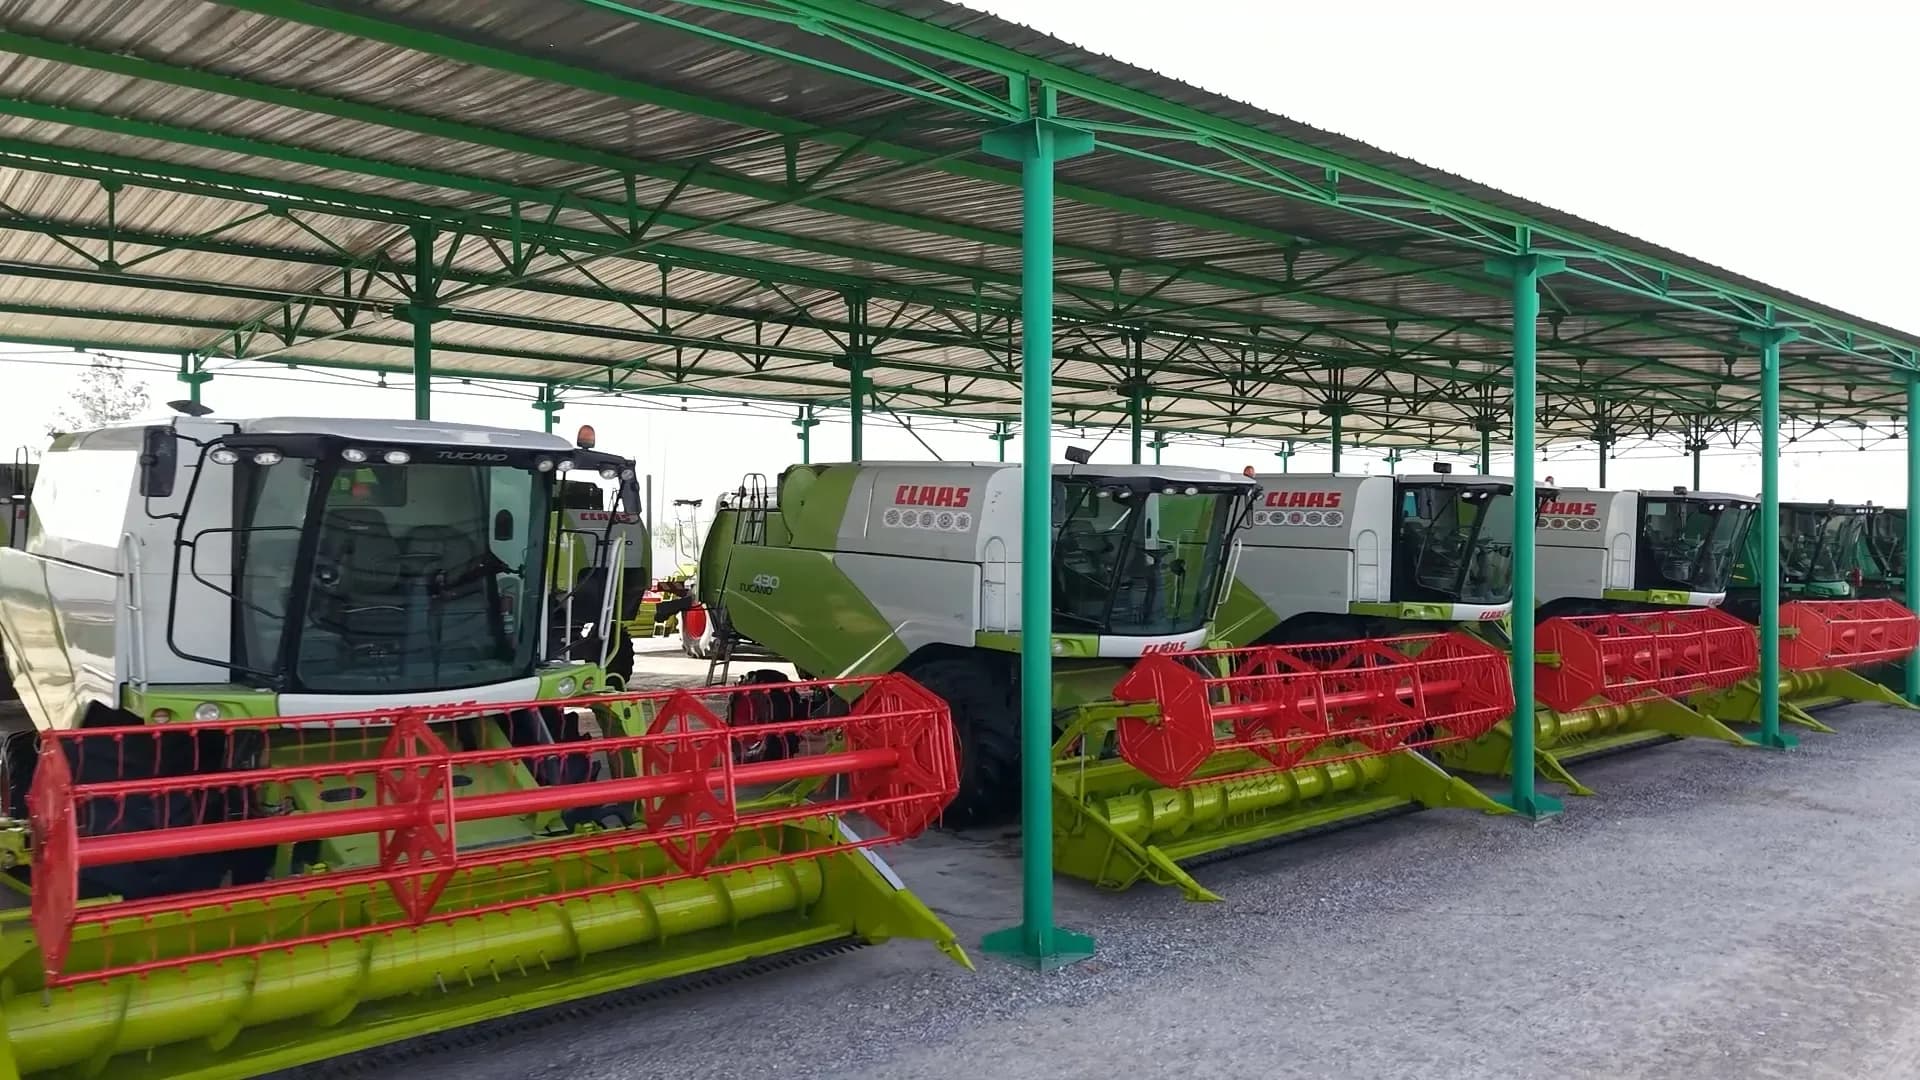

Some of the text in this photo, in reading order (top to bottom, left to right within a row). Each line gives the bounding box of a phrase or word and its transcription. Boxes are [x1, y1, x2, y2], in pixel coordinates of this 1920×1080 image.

[436, 451, 509, 461] TUCANO
[895, 485, 971, 508] CLAAS
[1265, 491, 1342, 508] CLAAS
[1538, 502, 1597, 516] LAAS
[753, 574, 780, 589] 430
[739, 583, 773, 595] TUCANO
